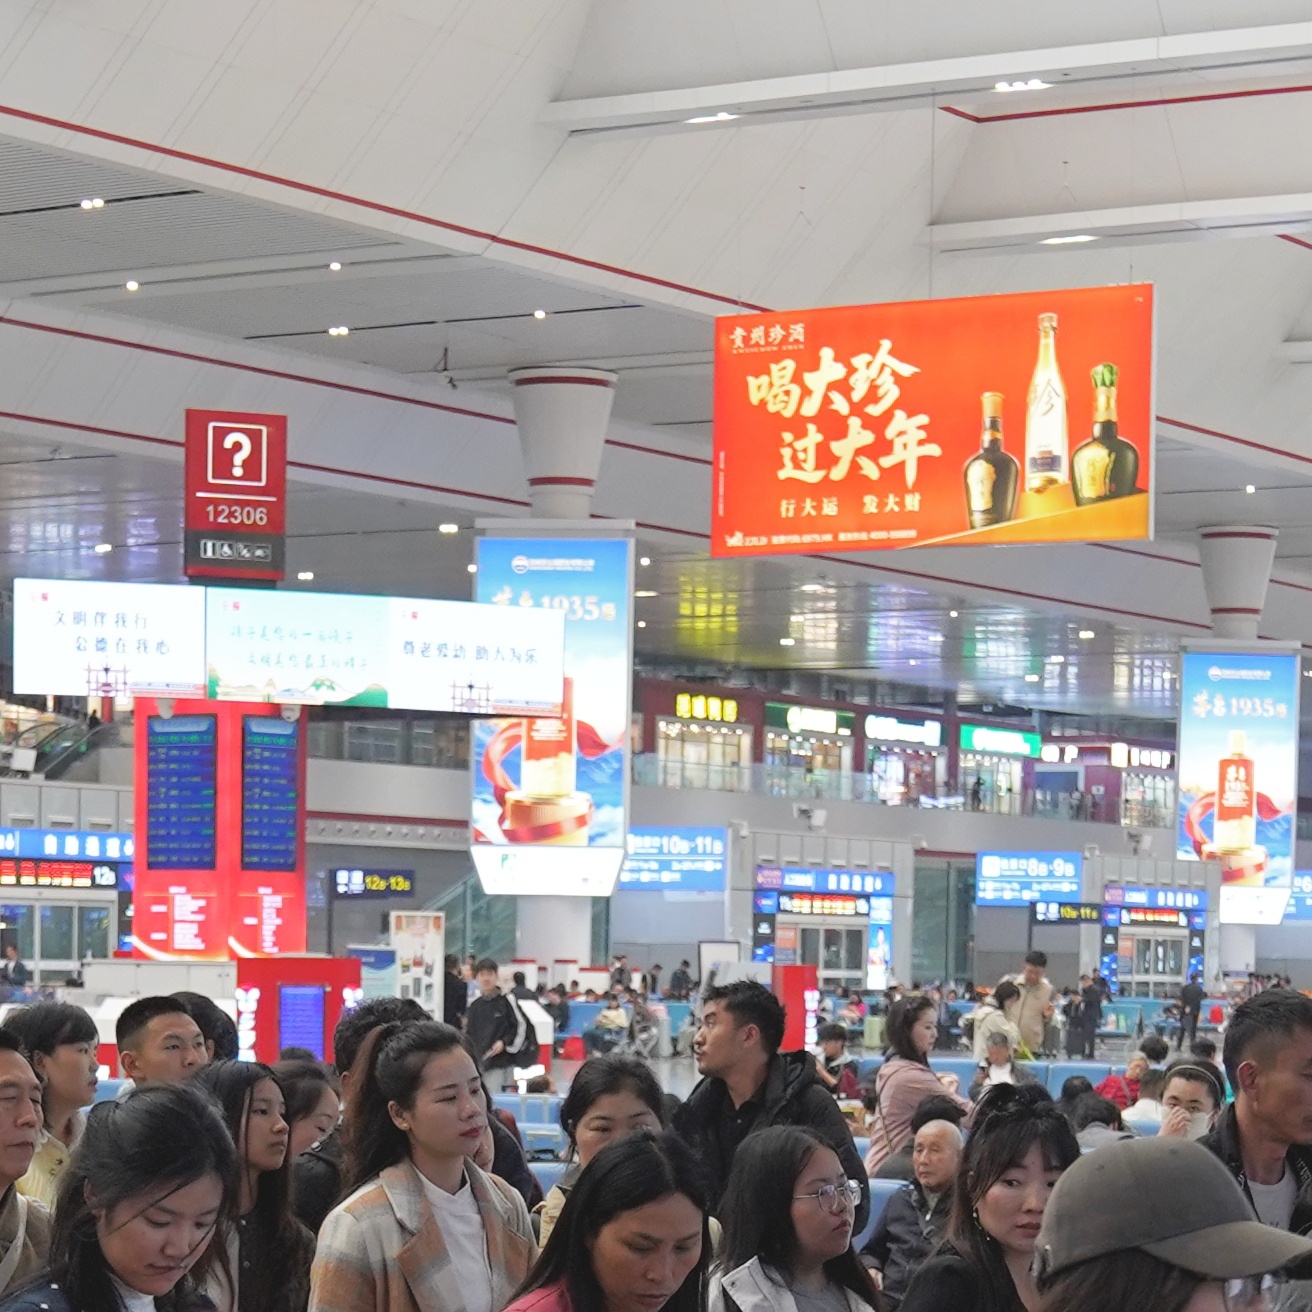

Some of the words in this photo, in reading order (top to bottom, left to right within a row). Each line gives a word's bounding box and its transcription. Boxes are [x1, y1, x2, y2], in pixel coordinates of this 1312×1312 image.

[729, 323, 805, 350] 贵州珍酒
[746, 339, 922, 418] 喝大珍
[777, 409, 943, 490] 过大年
[205, 503, 269, 526] 12306
[780, 497, 839, 519] 行大运
[862, 492, 922, 514] 发大财
